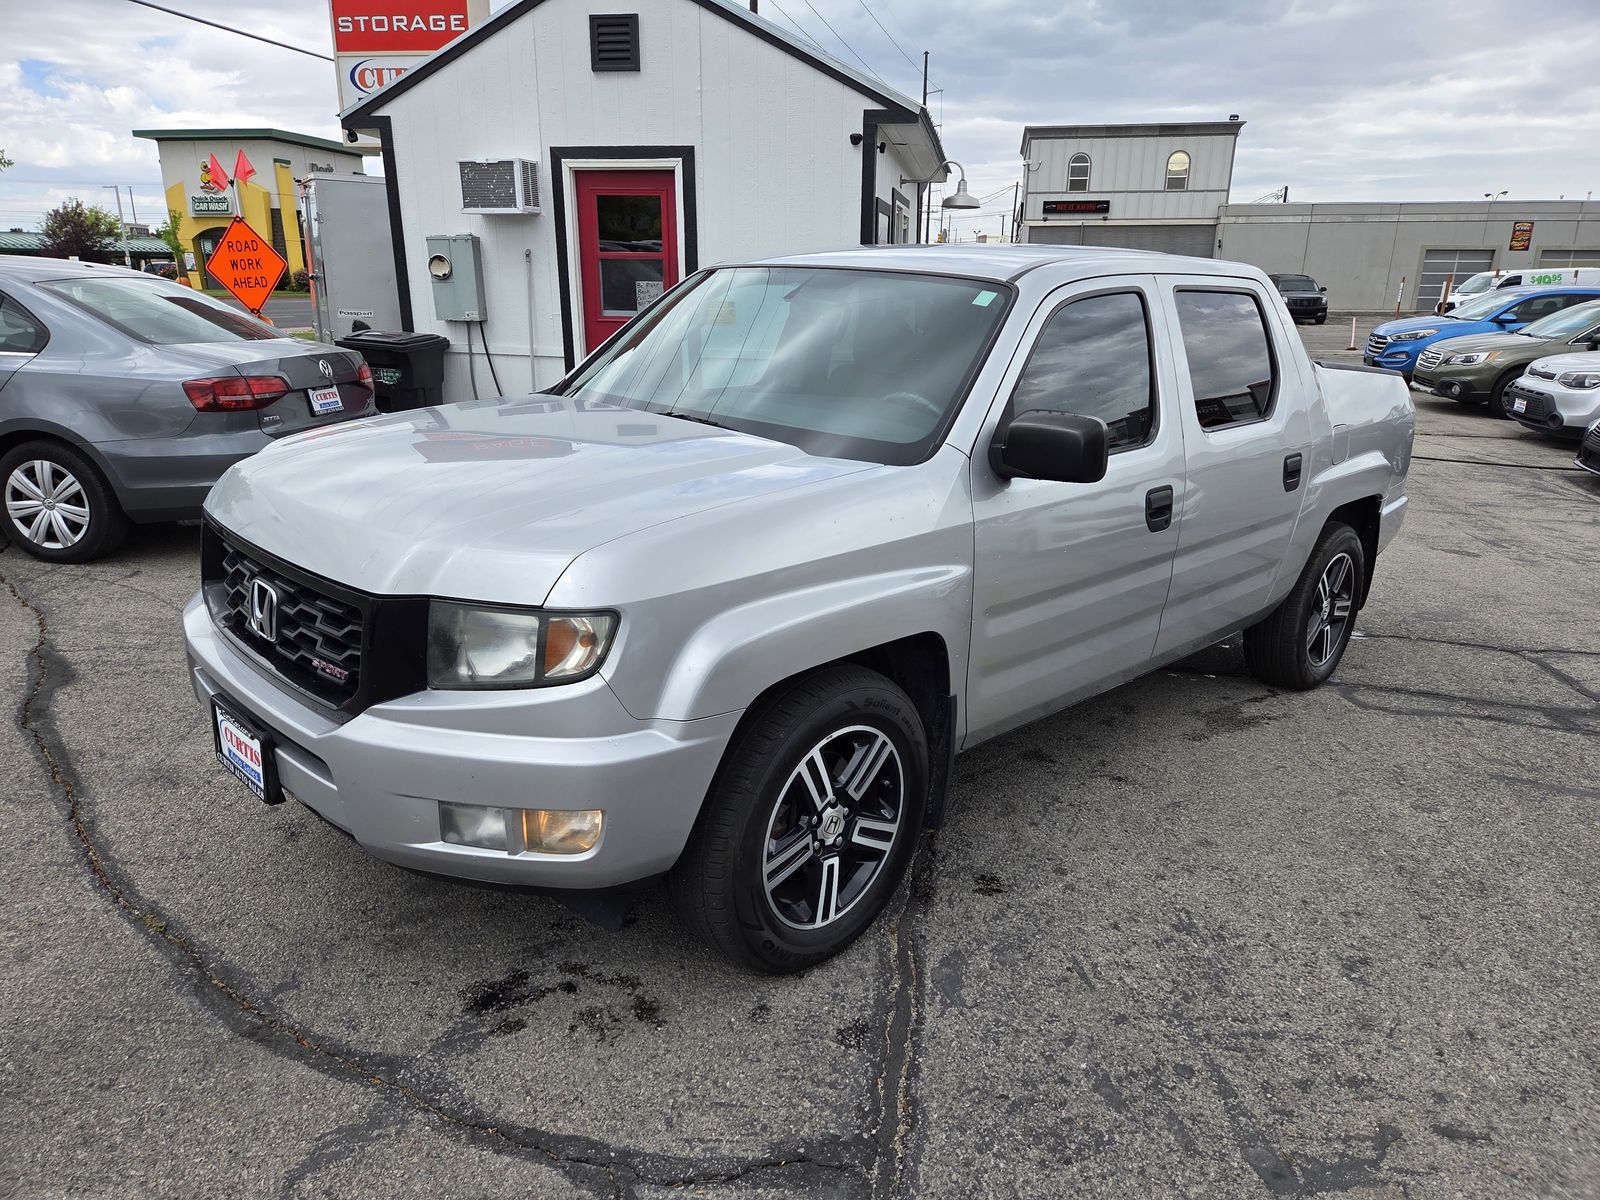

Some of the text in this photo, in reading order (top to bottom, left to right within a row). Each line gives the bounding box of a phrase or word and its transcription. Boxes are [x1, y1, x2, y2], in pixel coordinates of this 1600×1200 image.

[337, 14, 466, 32] STORAGE
[194, 201, 228, 211] CAR WASH
[227, 239, 259, 253] ROAD
[230, 258, 263, 271] WORK
[233, 276, 268, 289] AHEAD
[315, 391, 338, 401] CURTIS
[311, 657, 349, 680] SPORT
[224, 726, 261, 768] CURTIS
[230, 750, 259, 781] Auto Sales
[216, 751, 265, 801] CURTIS AUTO SALES
